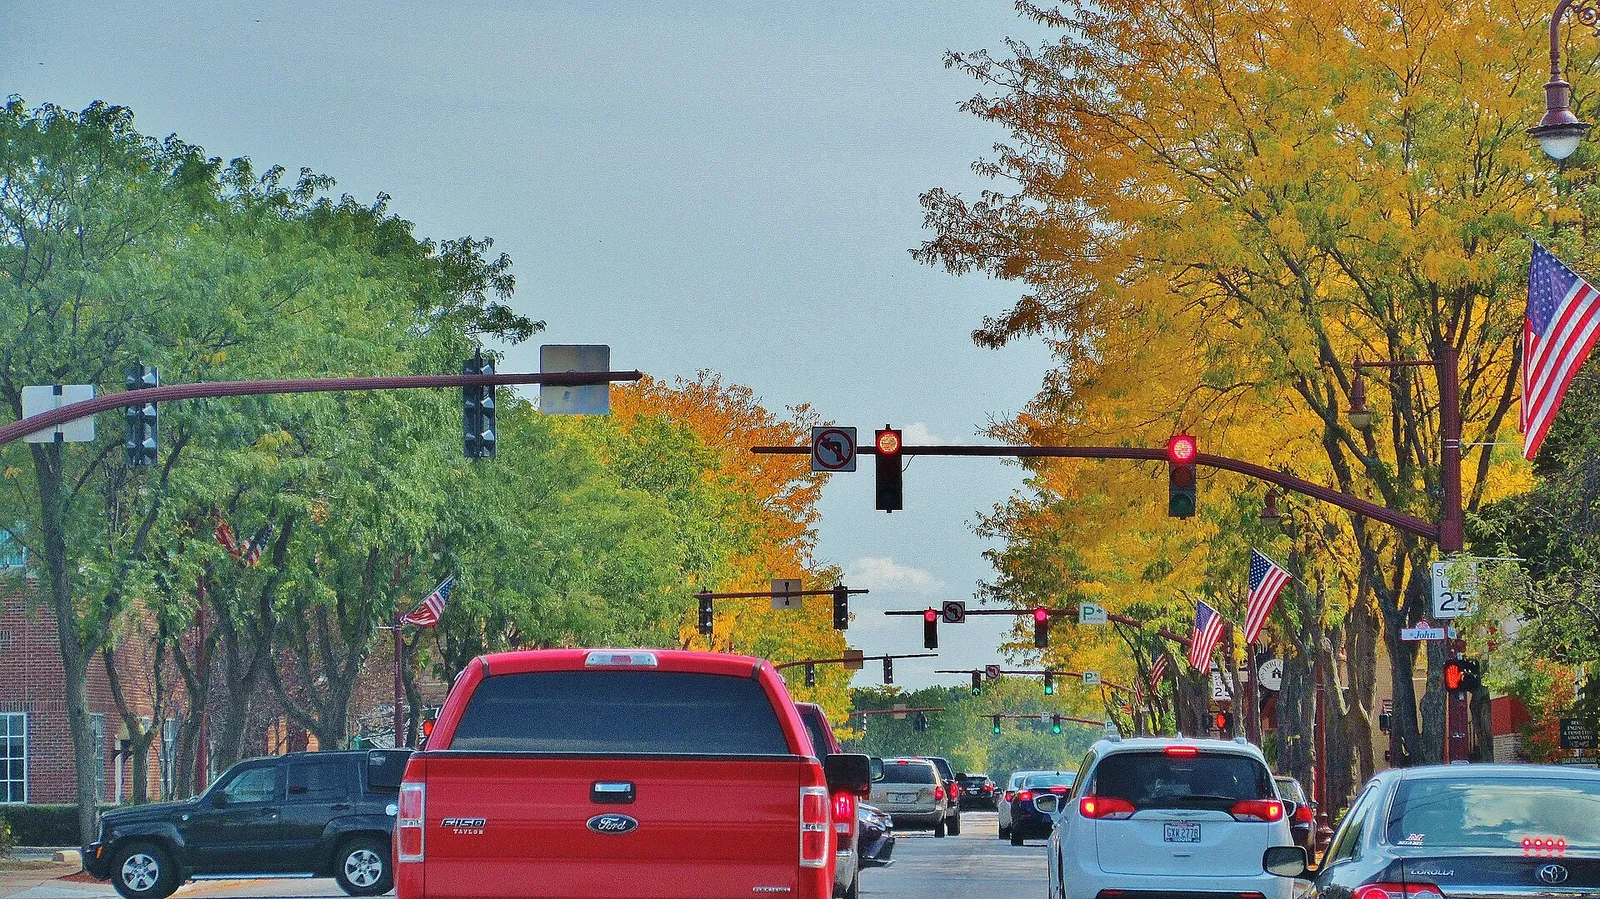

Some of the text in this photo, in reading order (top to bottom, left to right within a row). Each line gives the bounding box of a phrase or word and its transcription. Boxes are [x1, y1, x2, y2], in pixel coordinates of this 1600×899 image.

[1414, 630, 1436, 639] John
[440, 817, 487, 828] F150
[597, 817, 627, 830] Ford
